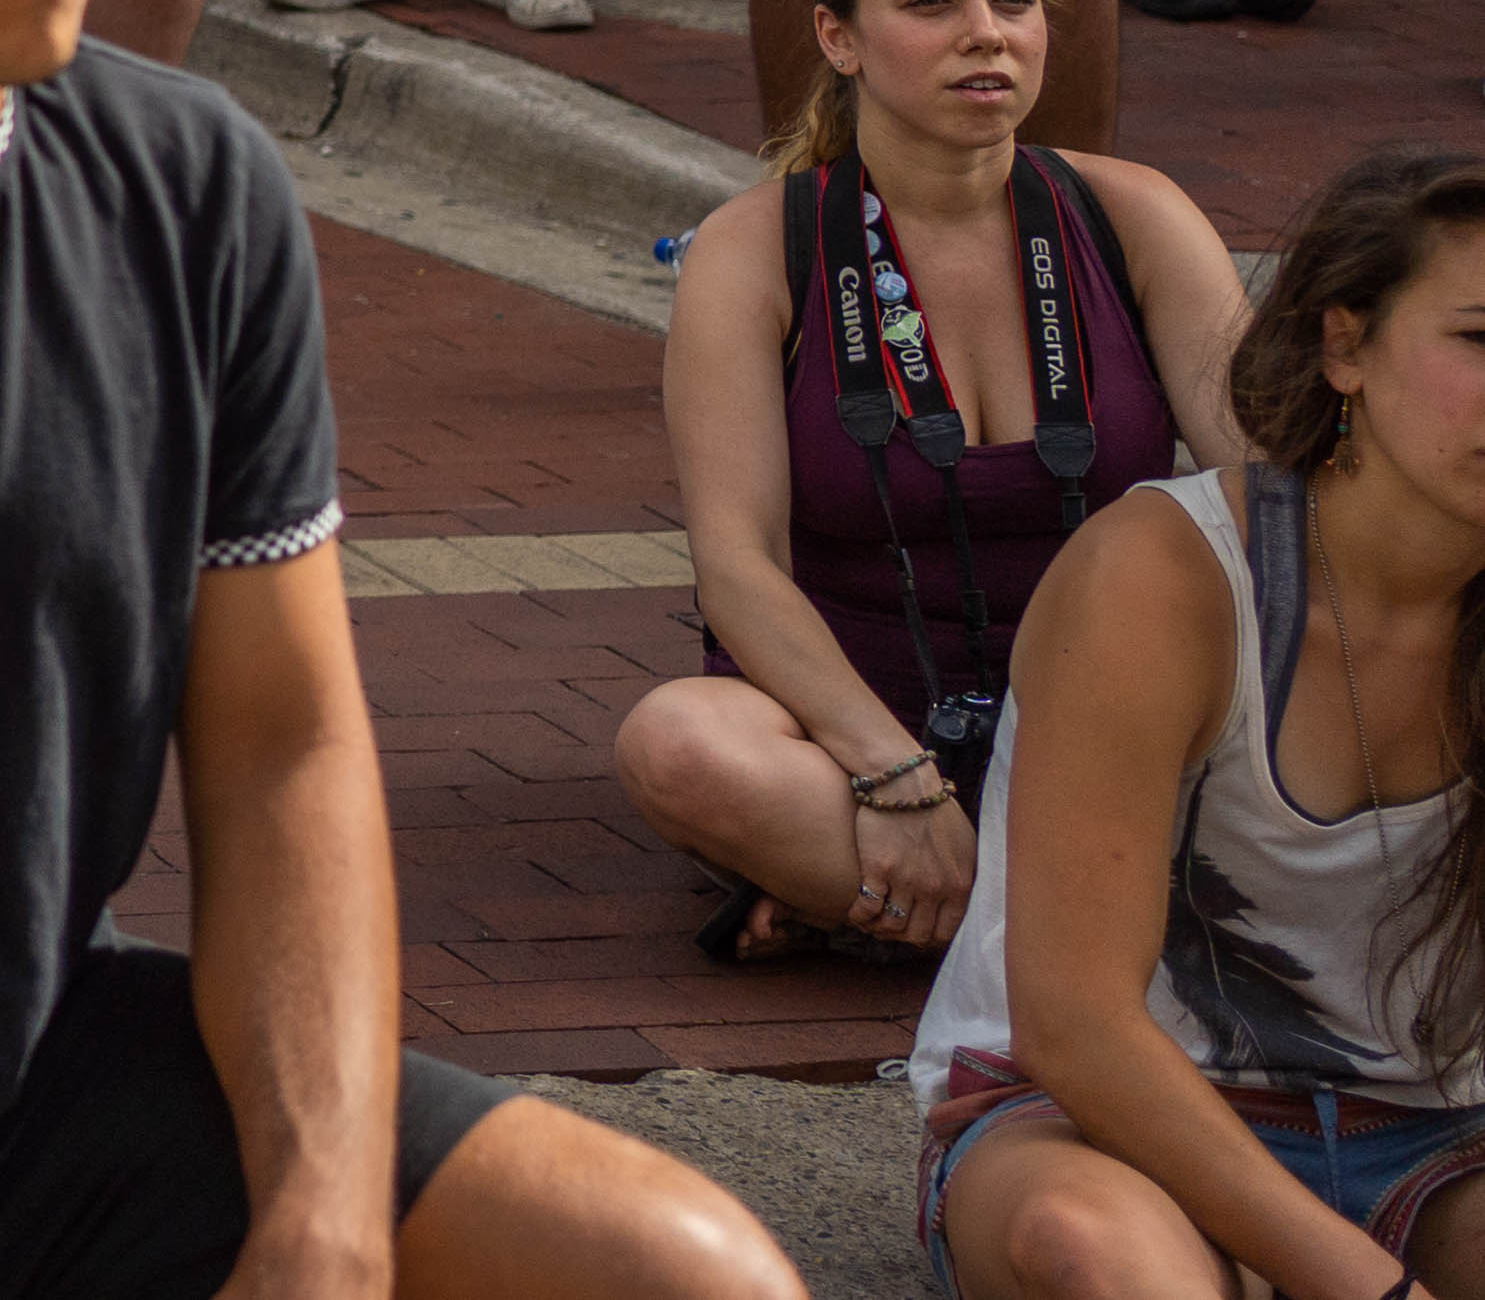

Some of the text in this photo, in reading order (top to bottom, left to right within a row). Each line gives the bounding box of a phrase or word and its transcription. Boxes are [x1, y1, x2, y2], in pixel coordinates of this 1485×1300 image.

[838, 266, 868, 363] Canon
[1030, 237, 1068, 400] EOS DIGITAL
